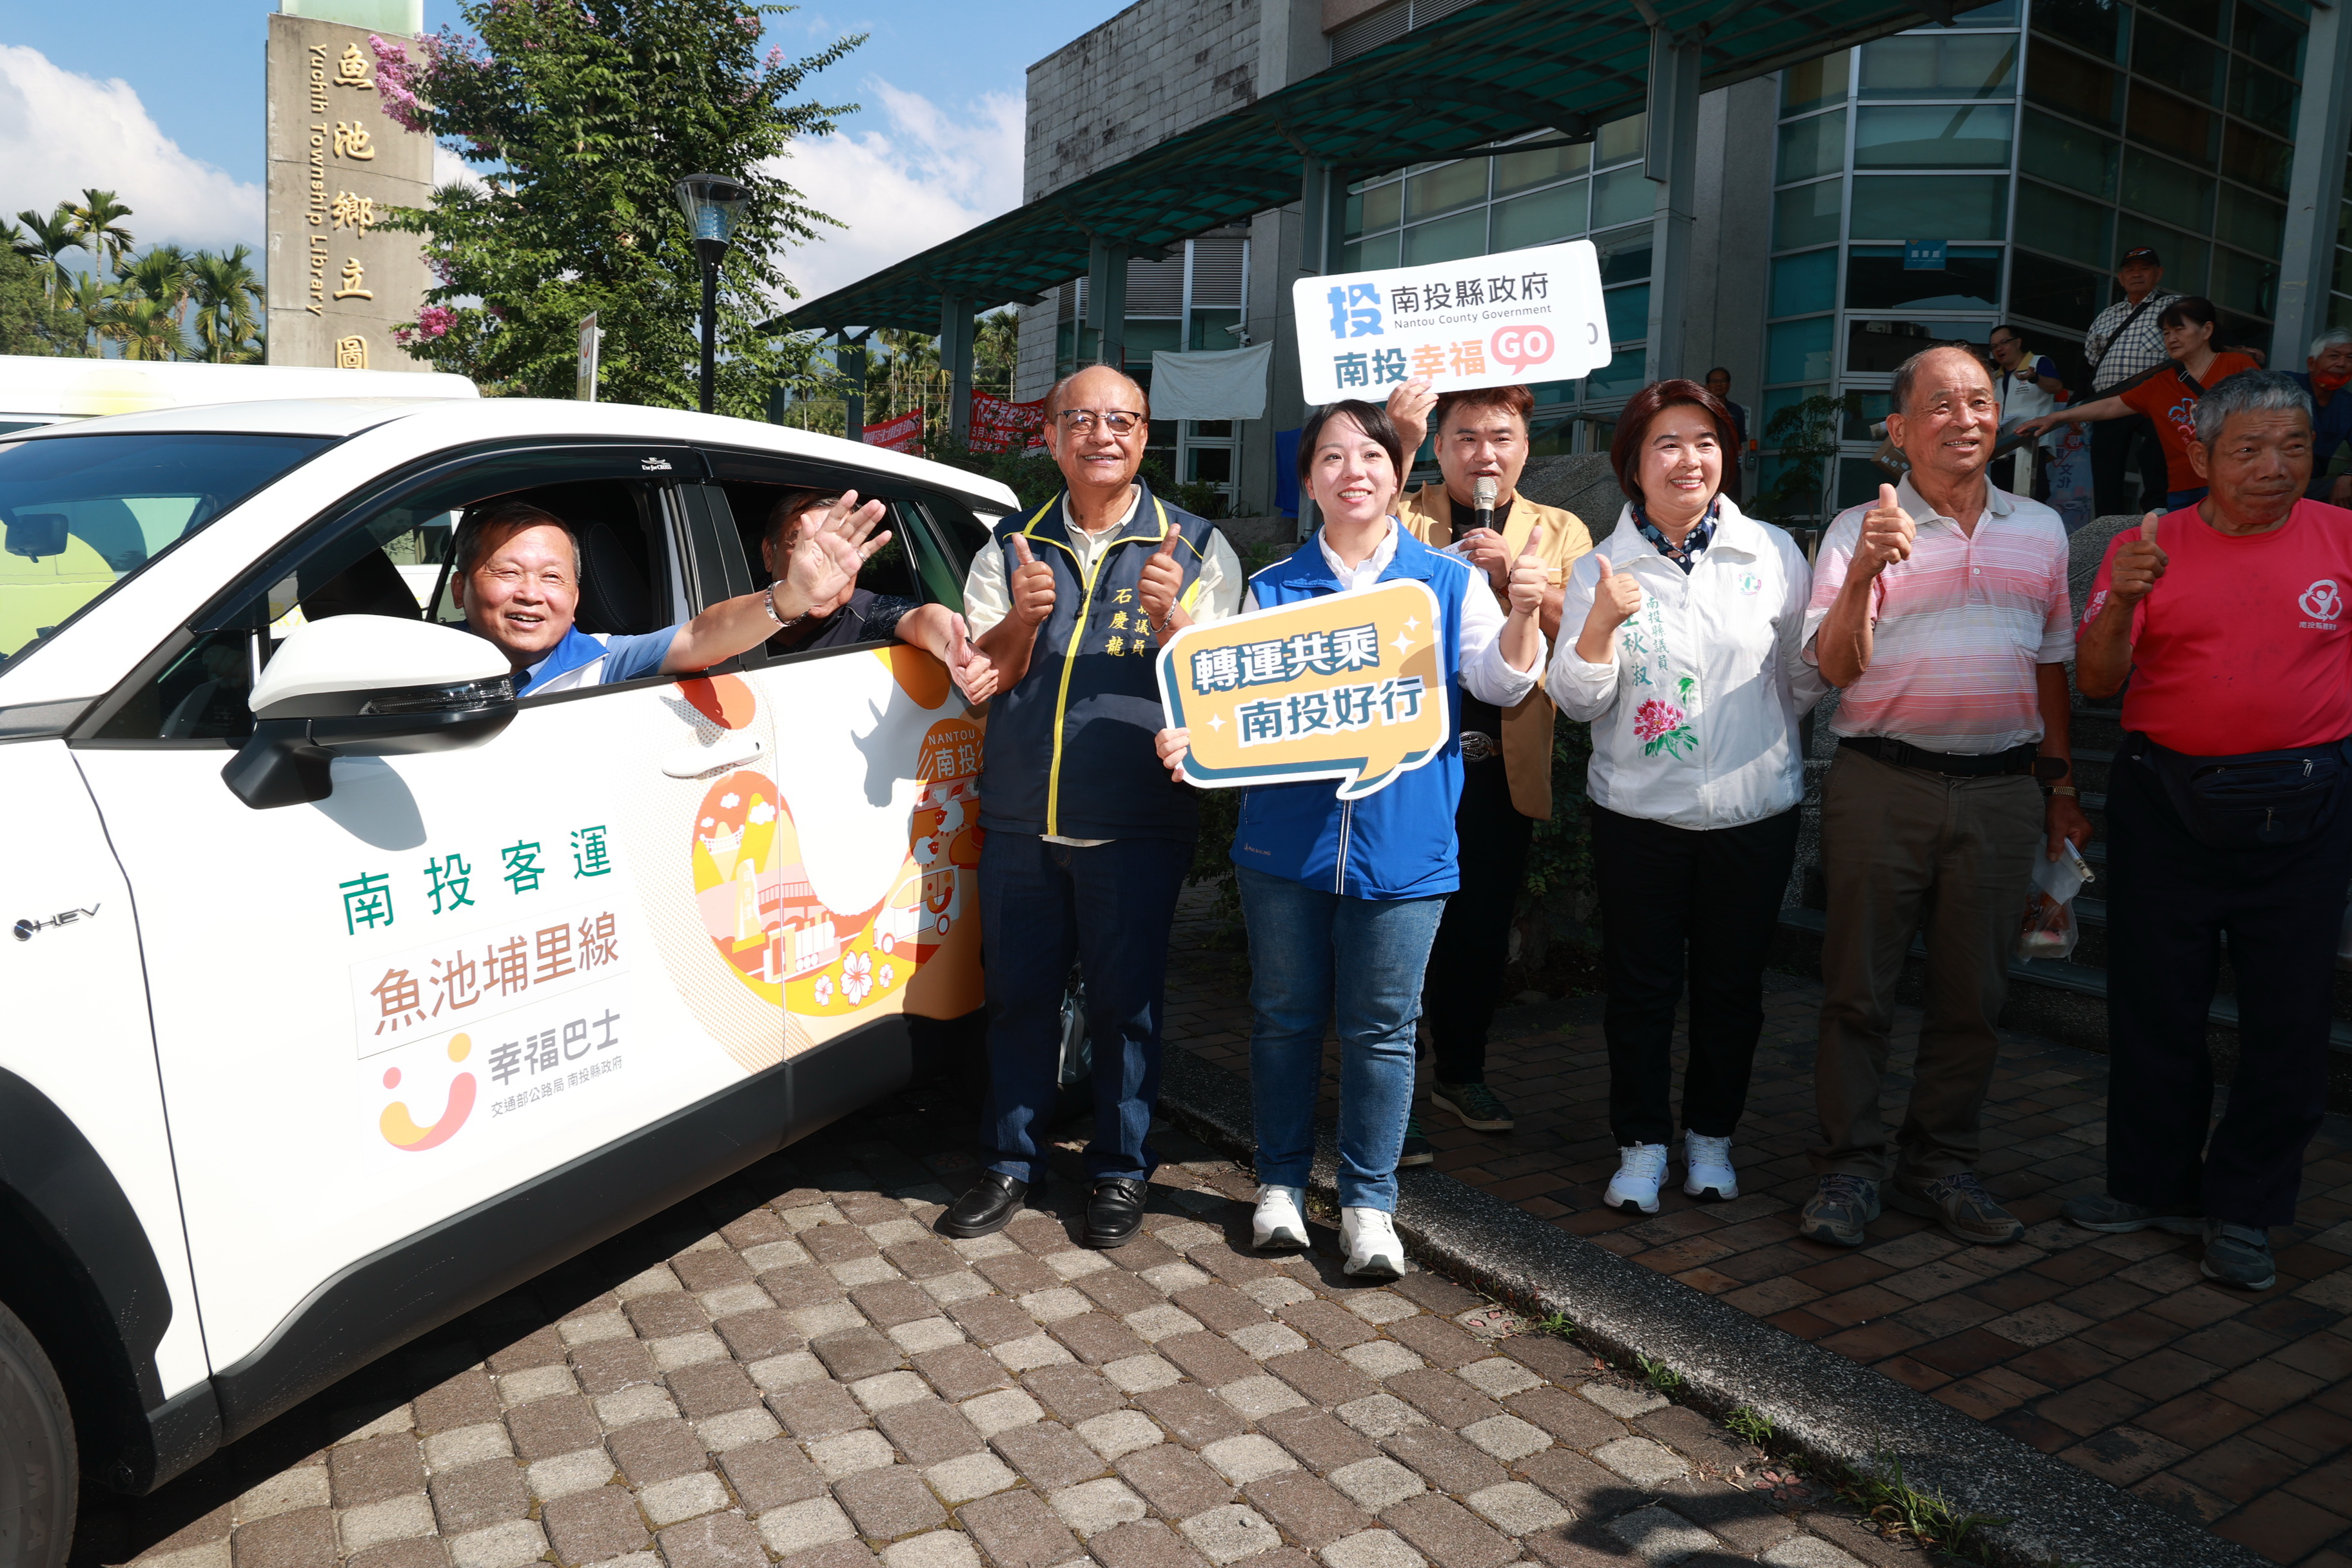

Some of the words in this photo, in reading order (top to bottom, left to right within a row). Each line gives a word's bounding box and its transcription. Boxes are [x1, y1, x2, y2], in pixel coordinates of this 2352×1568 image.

[309, 43, 328, 113] Yuchih
[306, 122, 328, 226] Township
[306, 235, 328, 317] Library
[1390, 271, 1549, 315] 南投縣政府
[1394, 317, 1435, 329] Nantou
[1438, 311, 1478, 325] County
[1482, 304, 1552, 320] Government
[1333, 339, 1487, 389] 南投幸福
[1498, 331, 1547, 358] GO
[1104, 588, 1133, 657] 石慶龍
[1646, 596, 1670, 671] 南投縣議員
[1193, 624, 1378, 692] 轉運共乘
[928, 729, 975, 745] NANTOU
[1239, 677, 1423, 743] 南投好行
[935, 744, 977, 778] 南投
[338, 825, 612, 936] 南投客運
[370, 911, 619, 1035] 魚池埔里線
[488, 1008, 621, 1086] 幸福巴士
[491, 1077, 565, 1118] 交通部公路局
[567, 1055, 623, 1090] 南投縣政府
